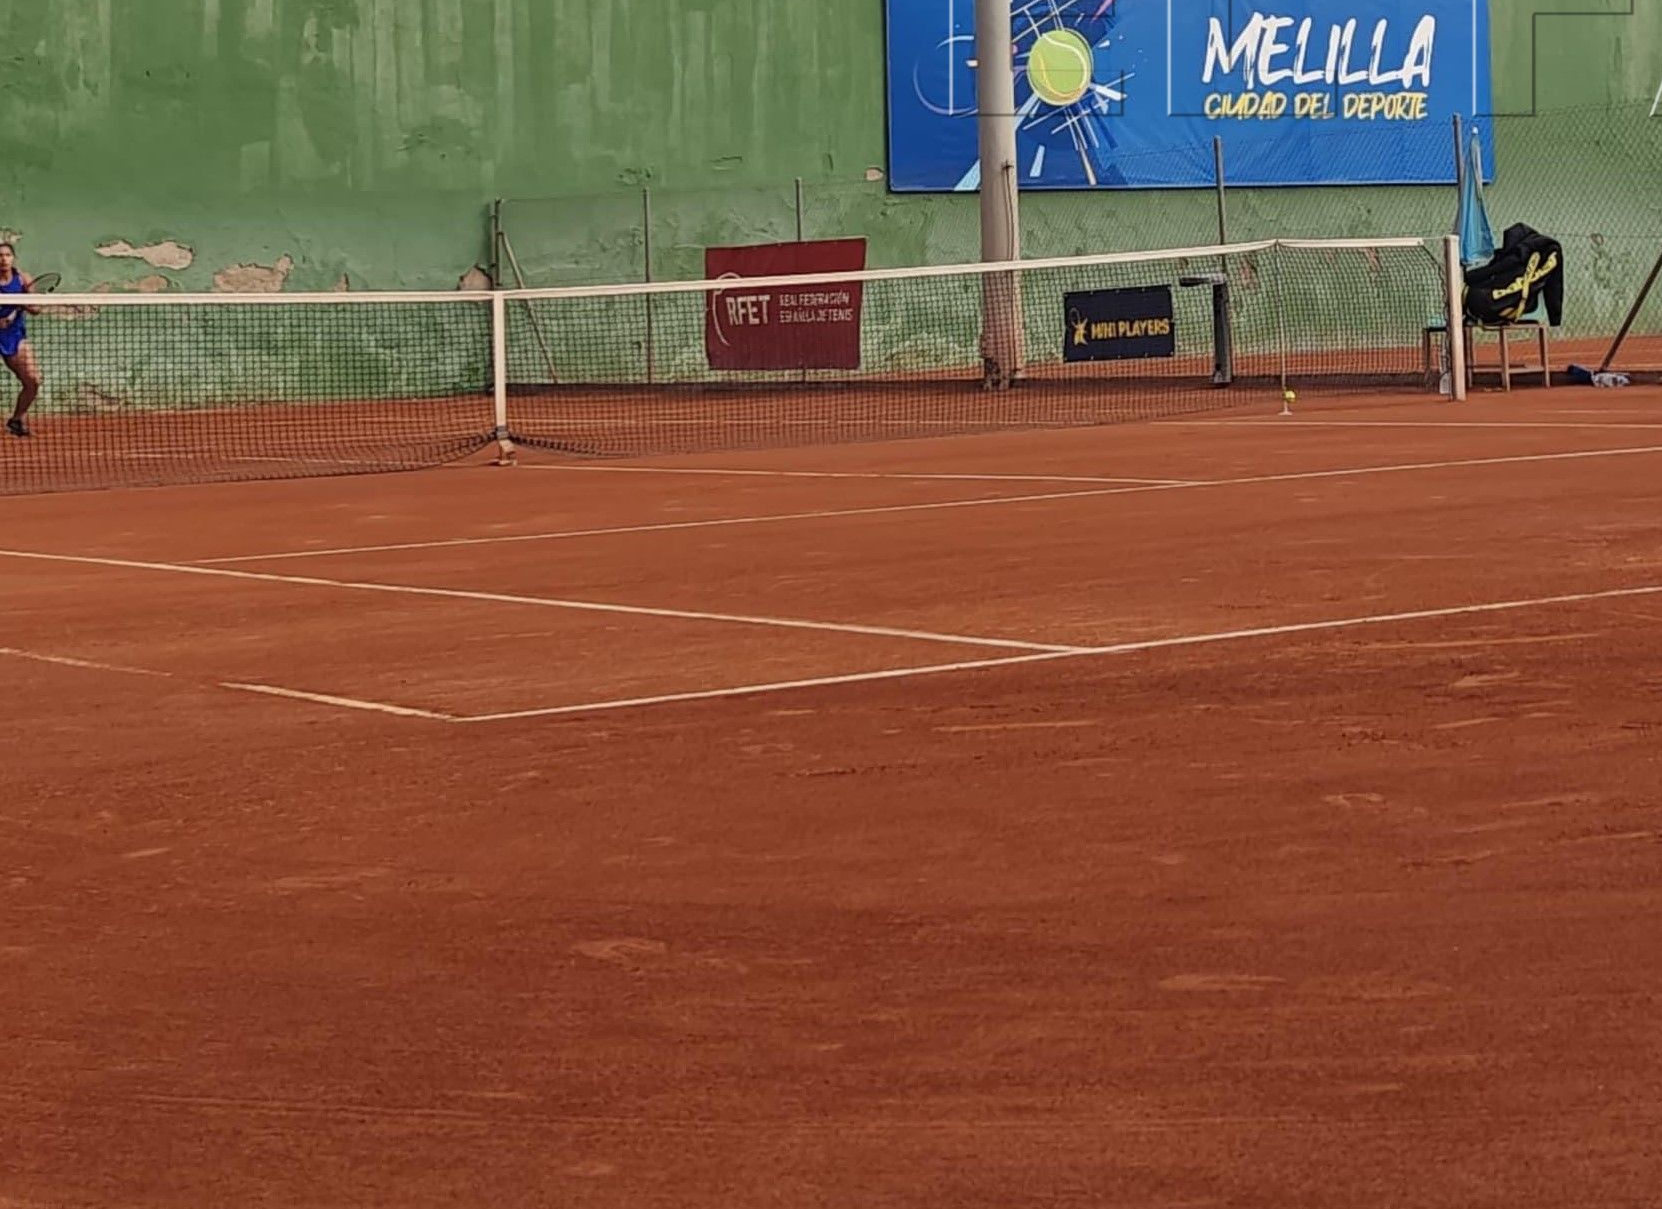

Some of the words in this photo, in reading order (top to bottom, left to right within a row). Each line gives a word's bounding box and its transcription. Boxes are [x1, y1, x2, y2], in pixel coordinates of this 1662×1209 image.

[1202, 12, 1436, 90] MELILLA
[1204, 91, 1288, 120] CIUDAD
[1293, 92, 1336, 120] DEL
[1342, 91, 1429, 121] DEPORTE
[726, 294, 771, 326] RFET
